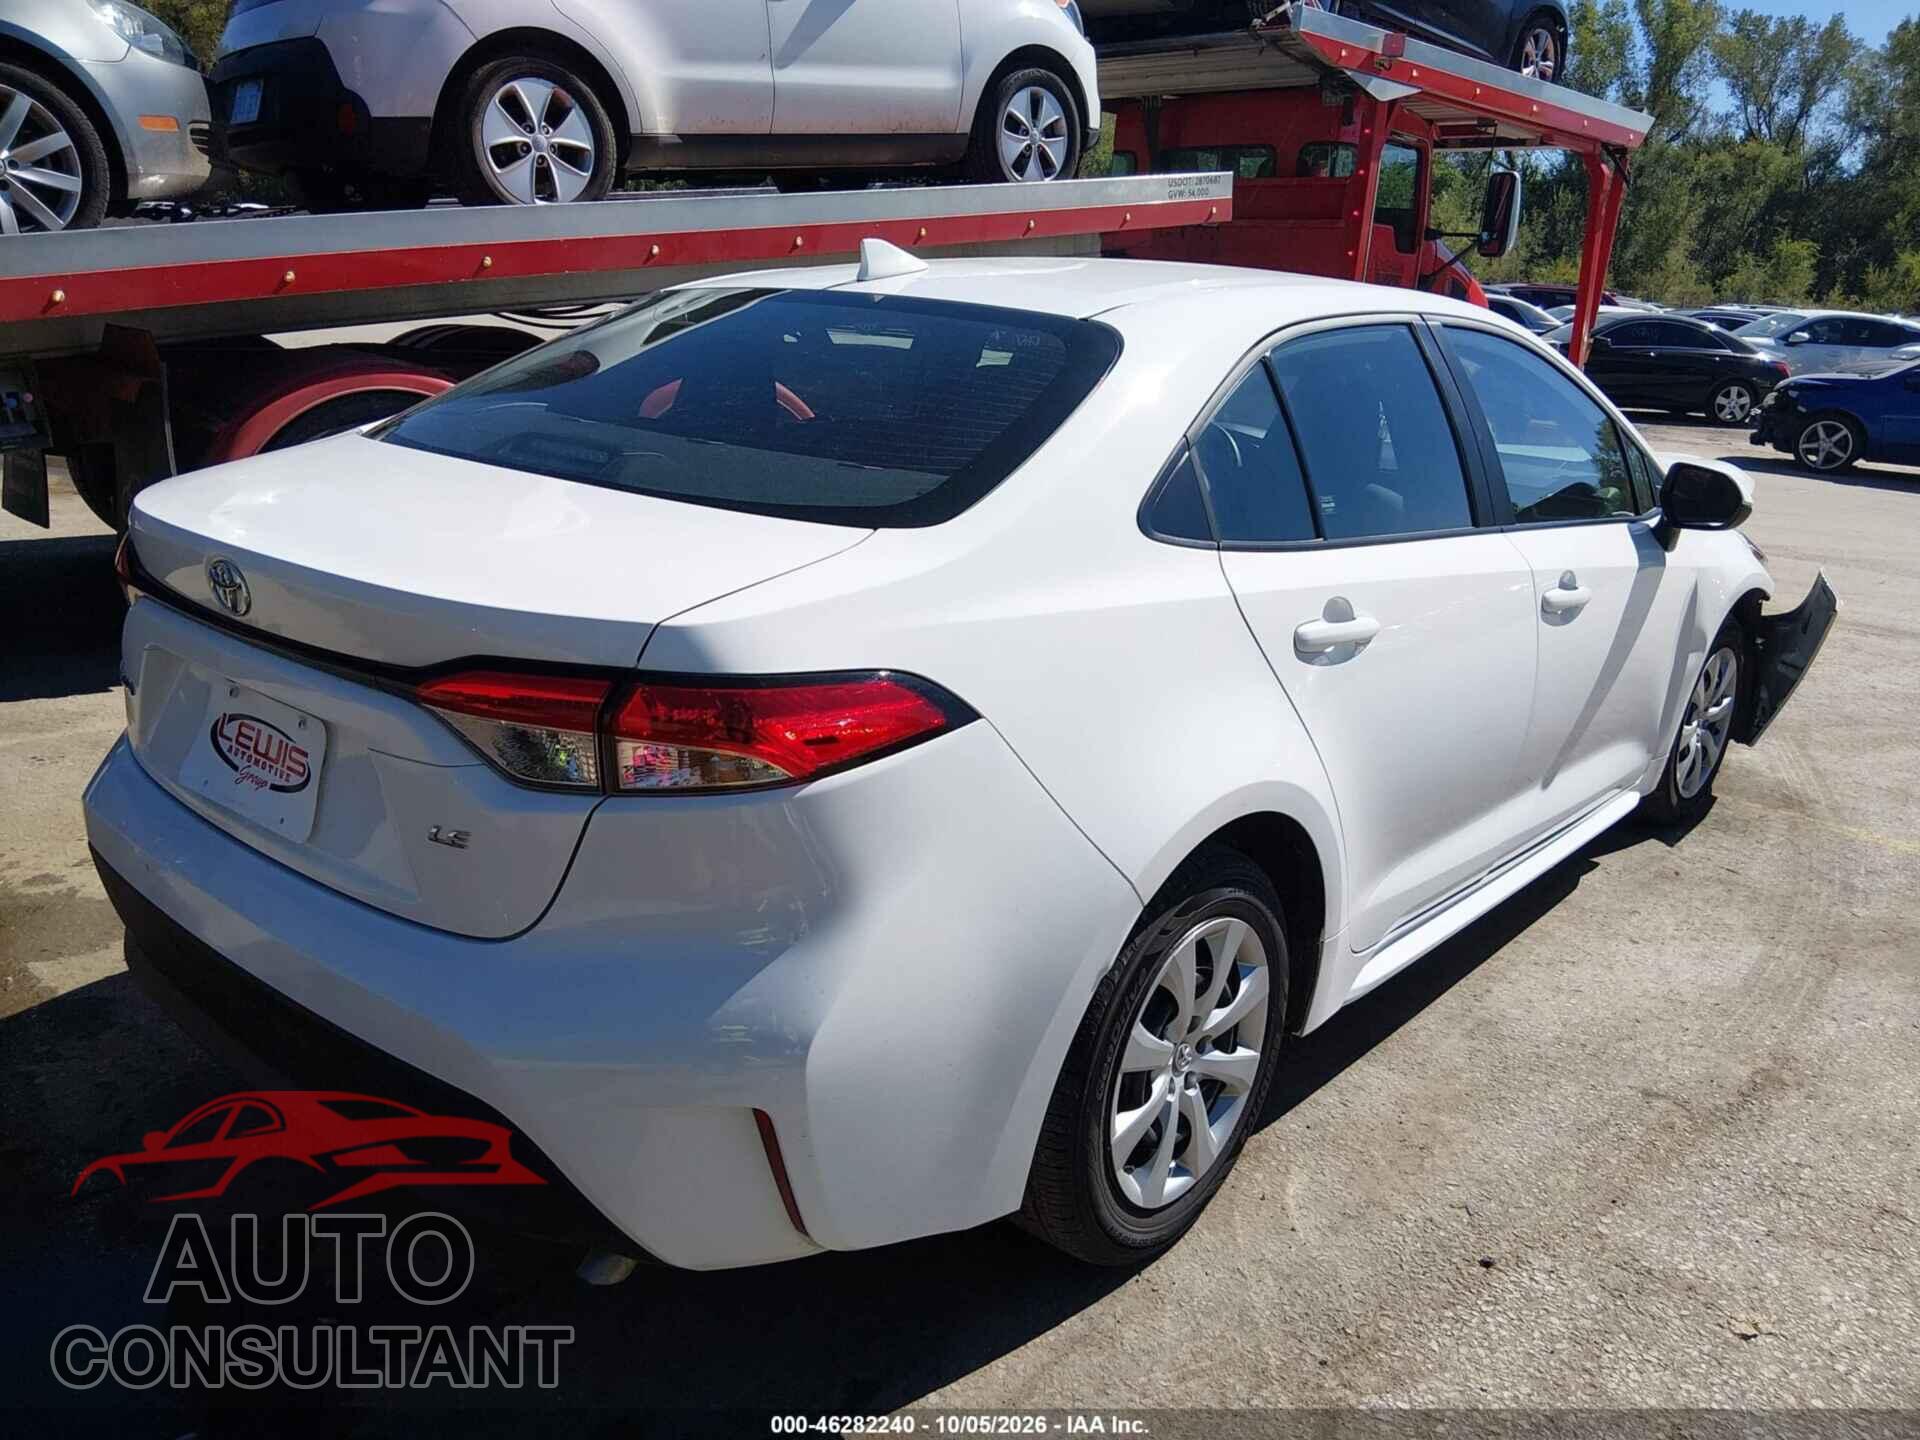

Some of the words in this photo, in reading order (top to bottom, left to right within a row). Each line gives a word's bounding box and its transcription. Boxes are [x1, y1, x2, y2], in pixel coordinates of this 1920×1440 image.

[218, 712, 309, 778] LEWIS
[226, 745, 291, 783] AUTOMOTIVE
[427, 825, 471, 849] LE
